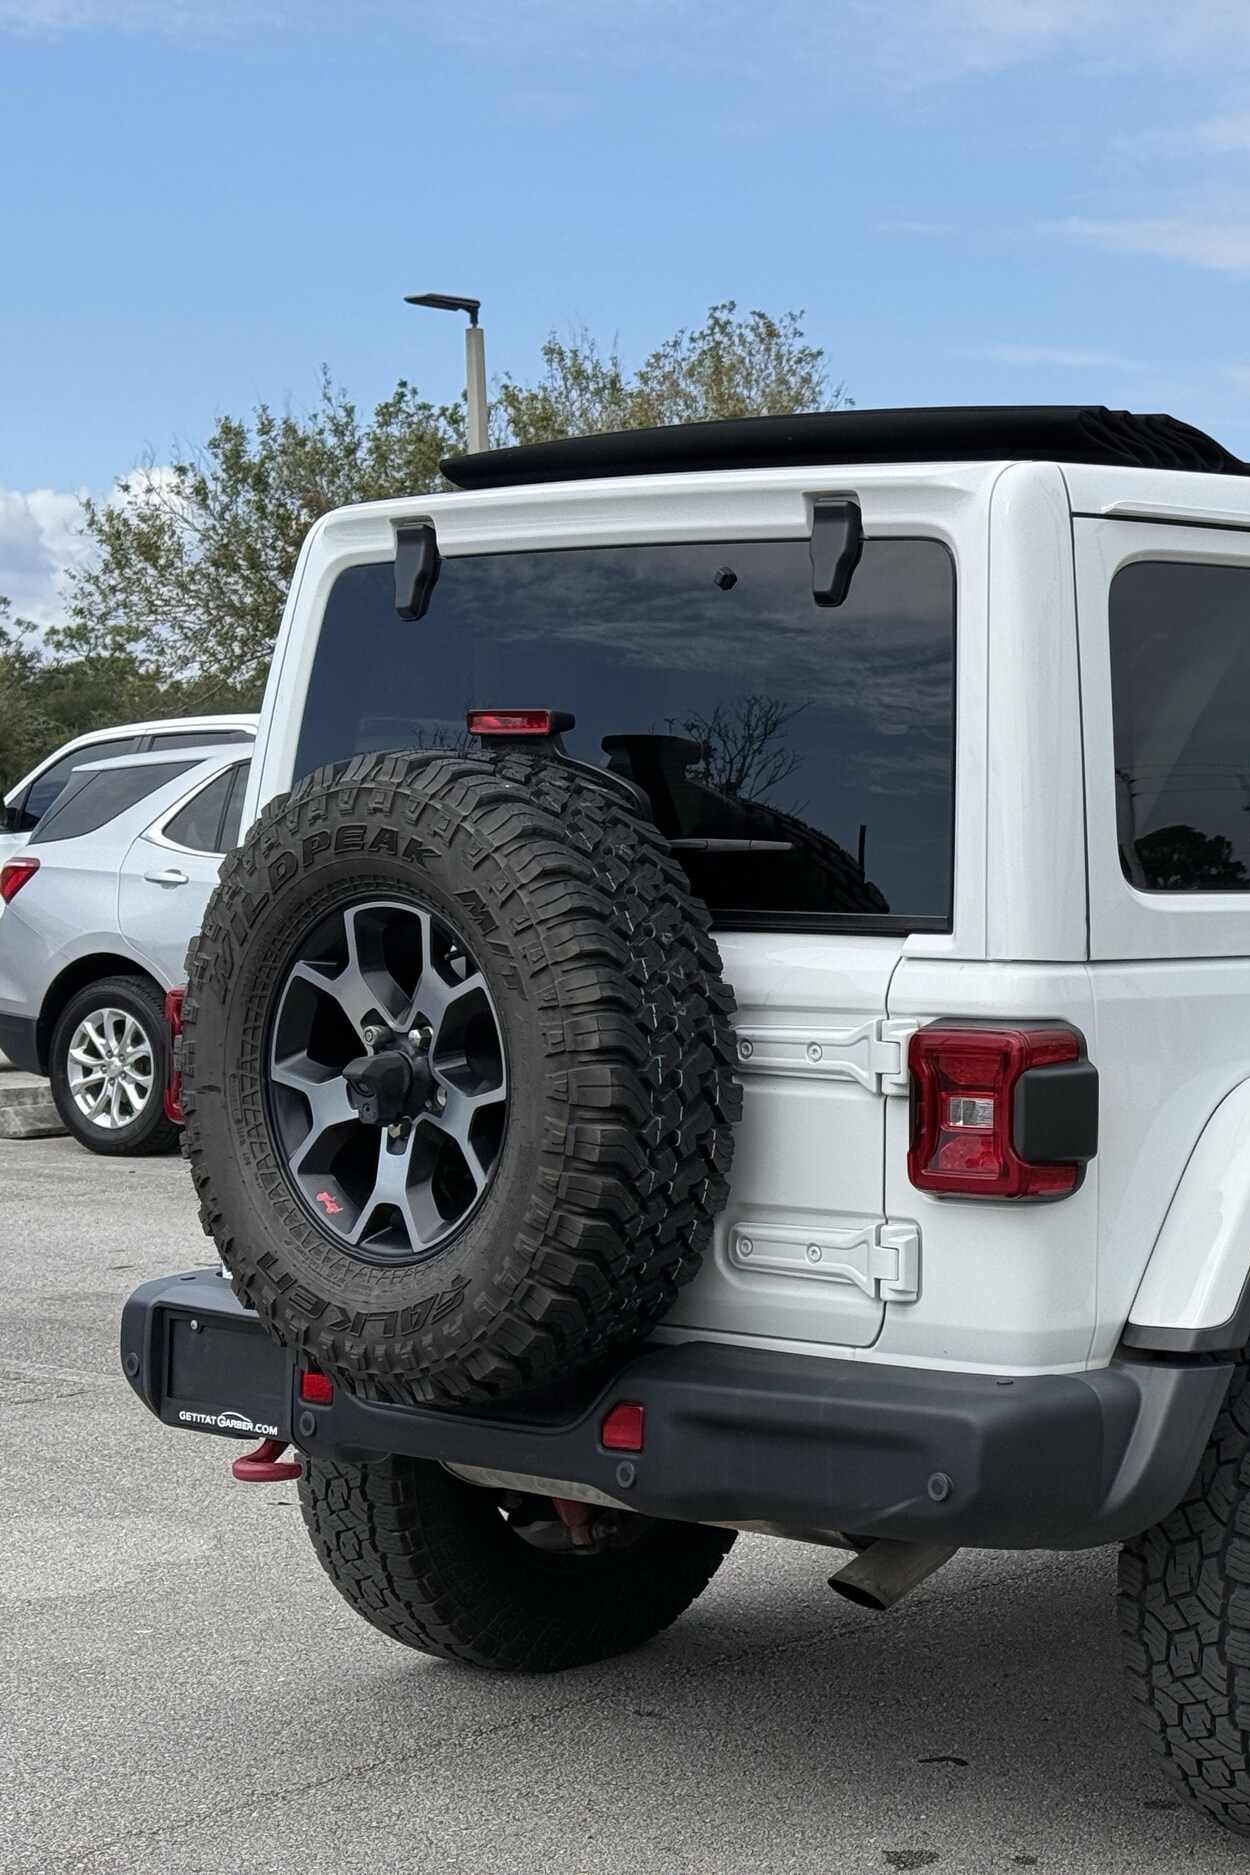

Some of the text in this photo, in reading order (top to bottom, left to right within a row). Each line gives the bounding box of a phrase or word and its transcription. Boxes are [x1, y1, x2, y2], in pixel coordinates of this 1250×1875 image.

[211, 823, 442, 1005] WILDPEAK
[255, 1251, 472, 1339] FALKEN
[179, 1410, 278, 1436] GETITATGARBER.COM
